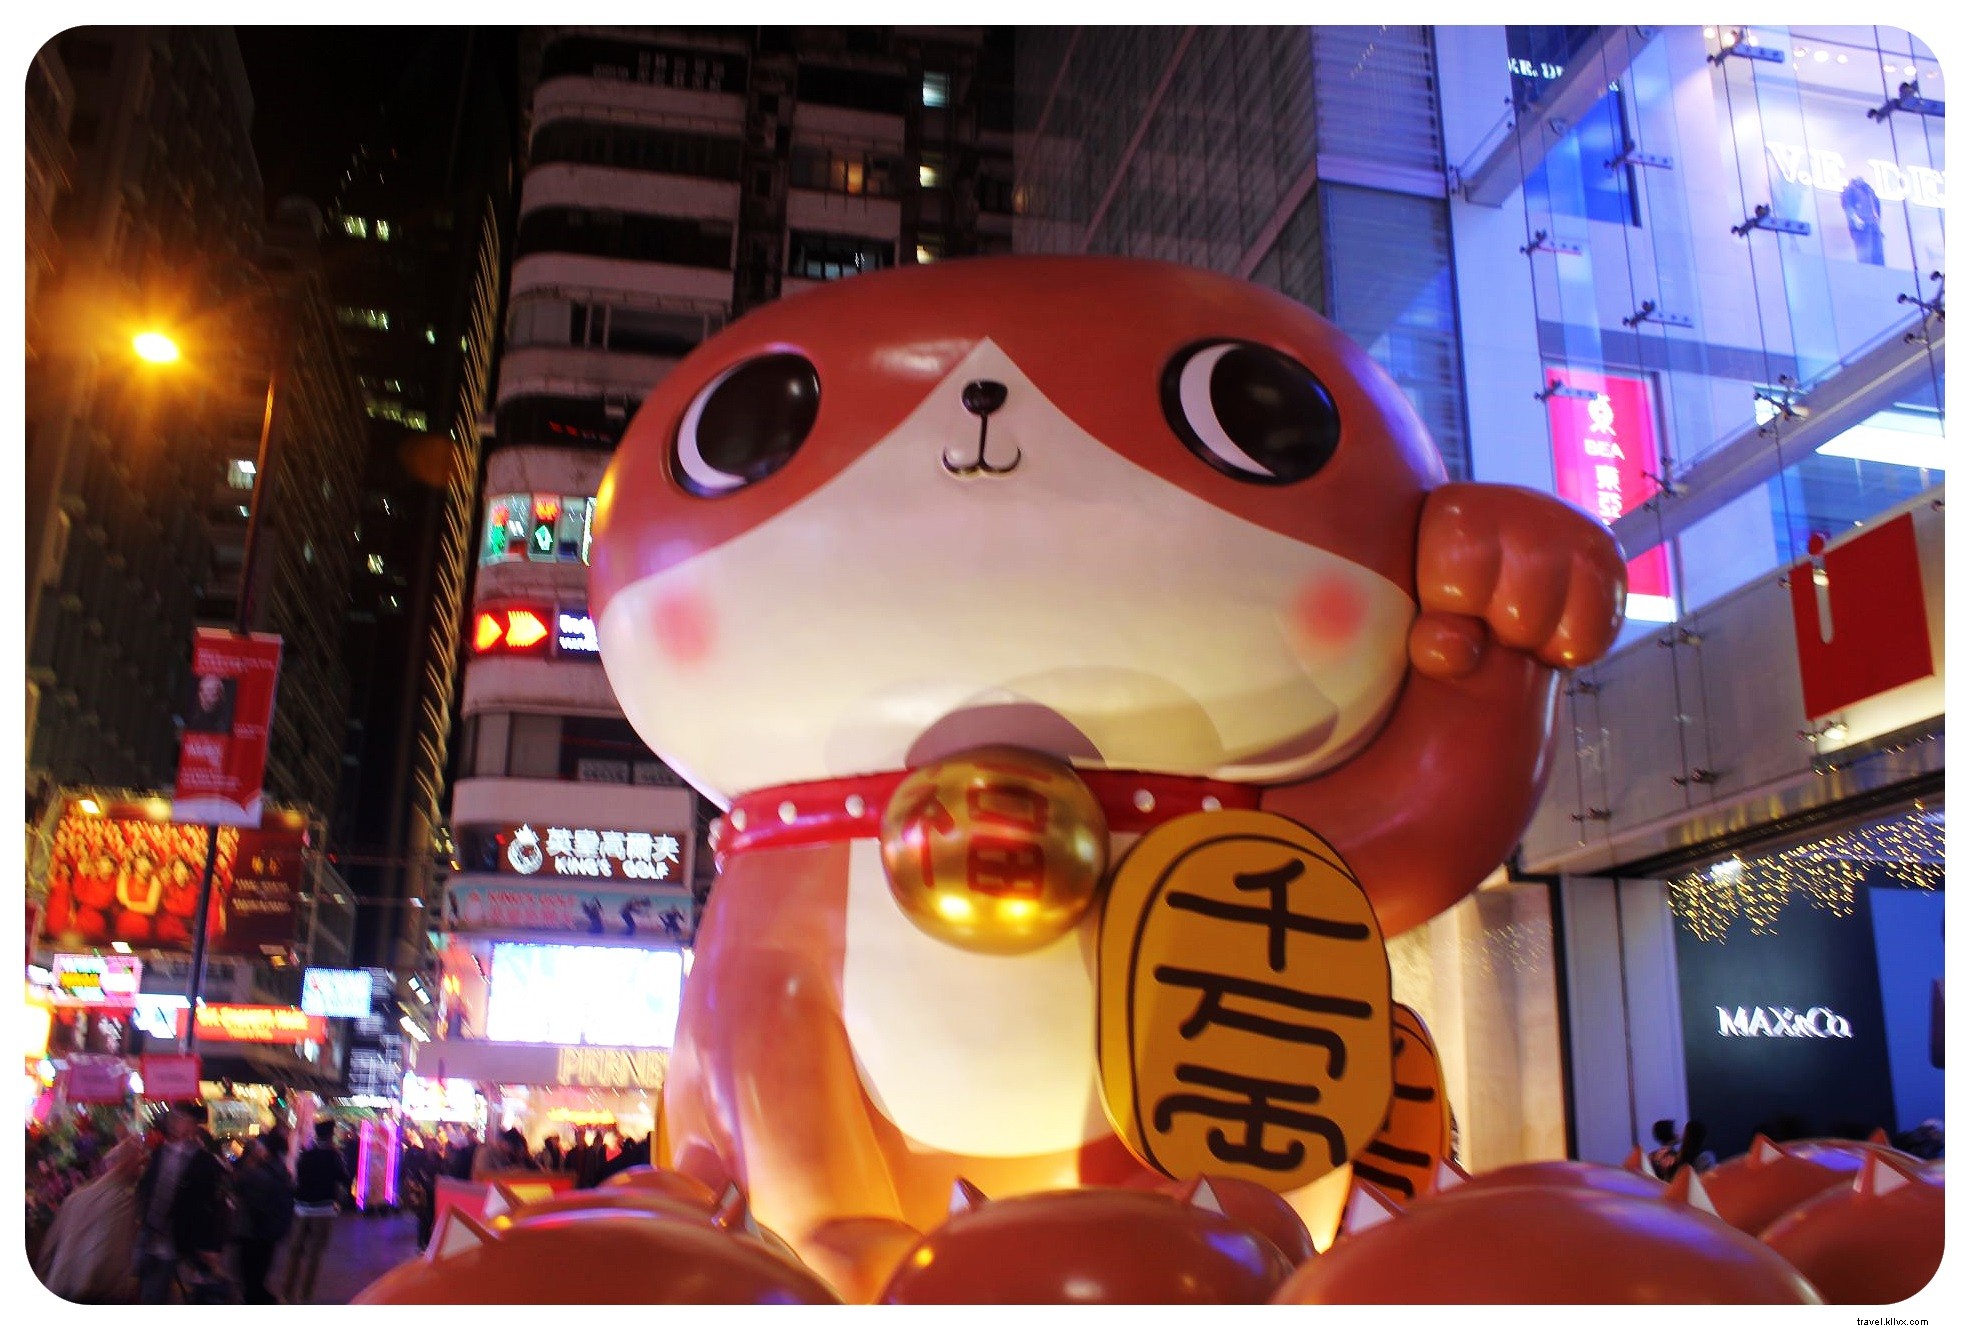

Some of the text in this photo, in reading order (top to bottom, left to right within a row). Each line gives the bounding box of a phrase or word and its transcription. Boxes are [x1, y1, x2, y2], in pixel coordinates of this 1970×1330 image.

[1584, 438, 1625, 460] BEA
[546, 827, 679, 864] 英皇高爾夫
[622, 860, 670, 880] GOLF
